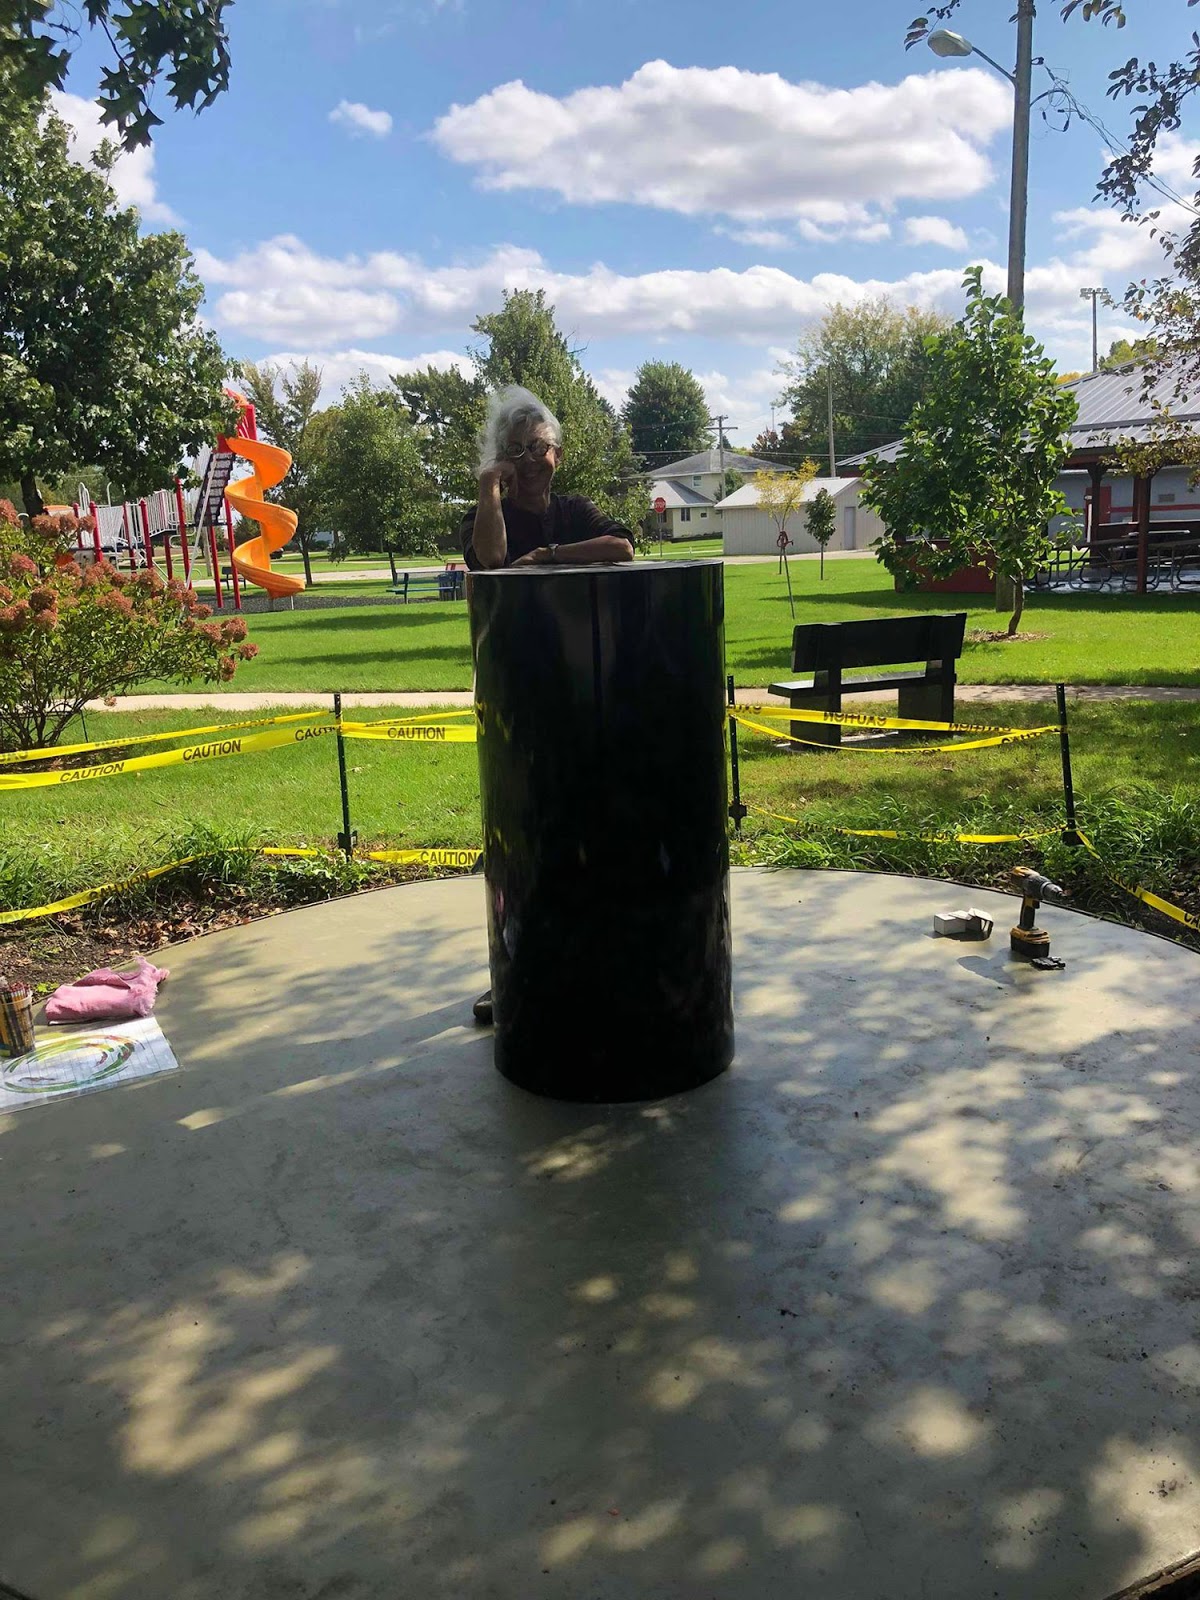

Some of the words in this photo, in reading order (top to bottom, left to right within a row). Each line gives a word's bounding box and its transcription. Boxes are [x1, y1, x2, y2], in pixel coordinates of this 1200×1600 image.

[387, 727, 446, 740] CAUTION
[183, 739, 241, 761] CAUTION
[60, 762, 125, 783] CAUTION
[420, 851, 477, 865] CAUTION
